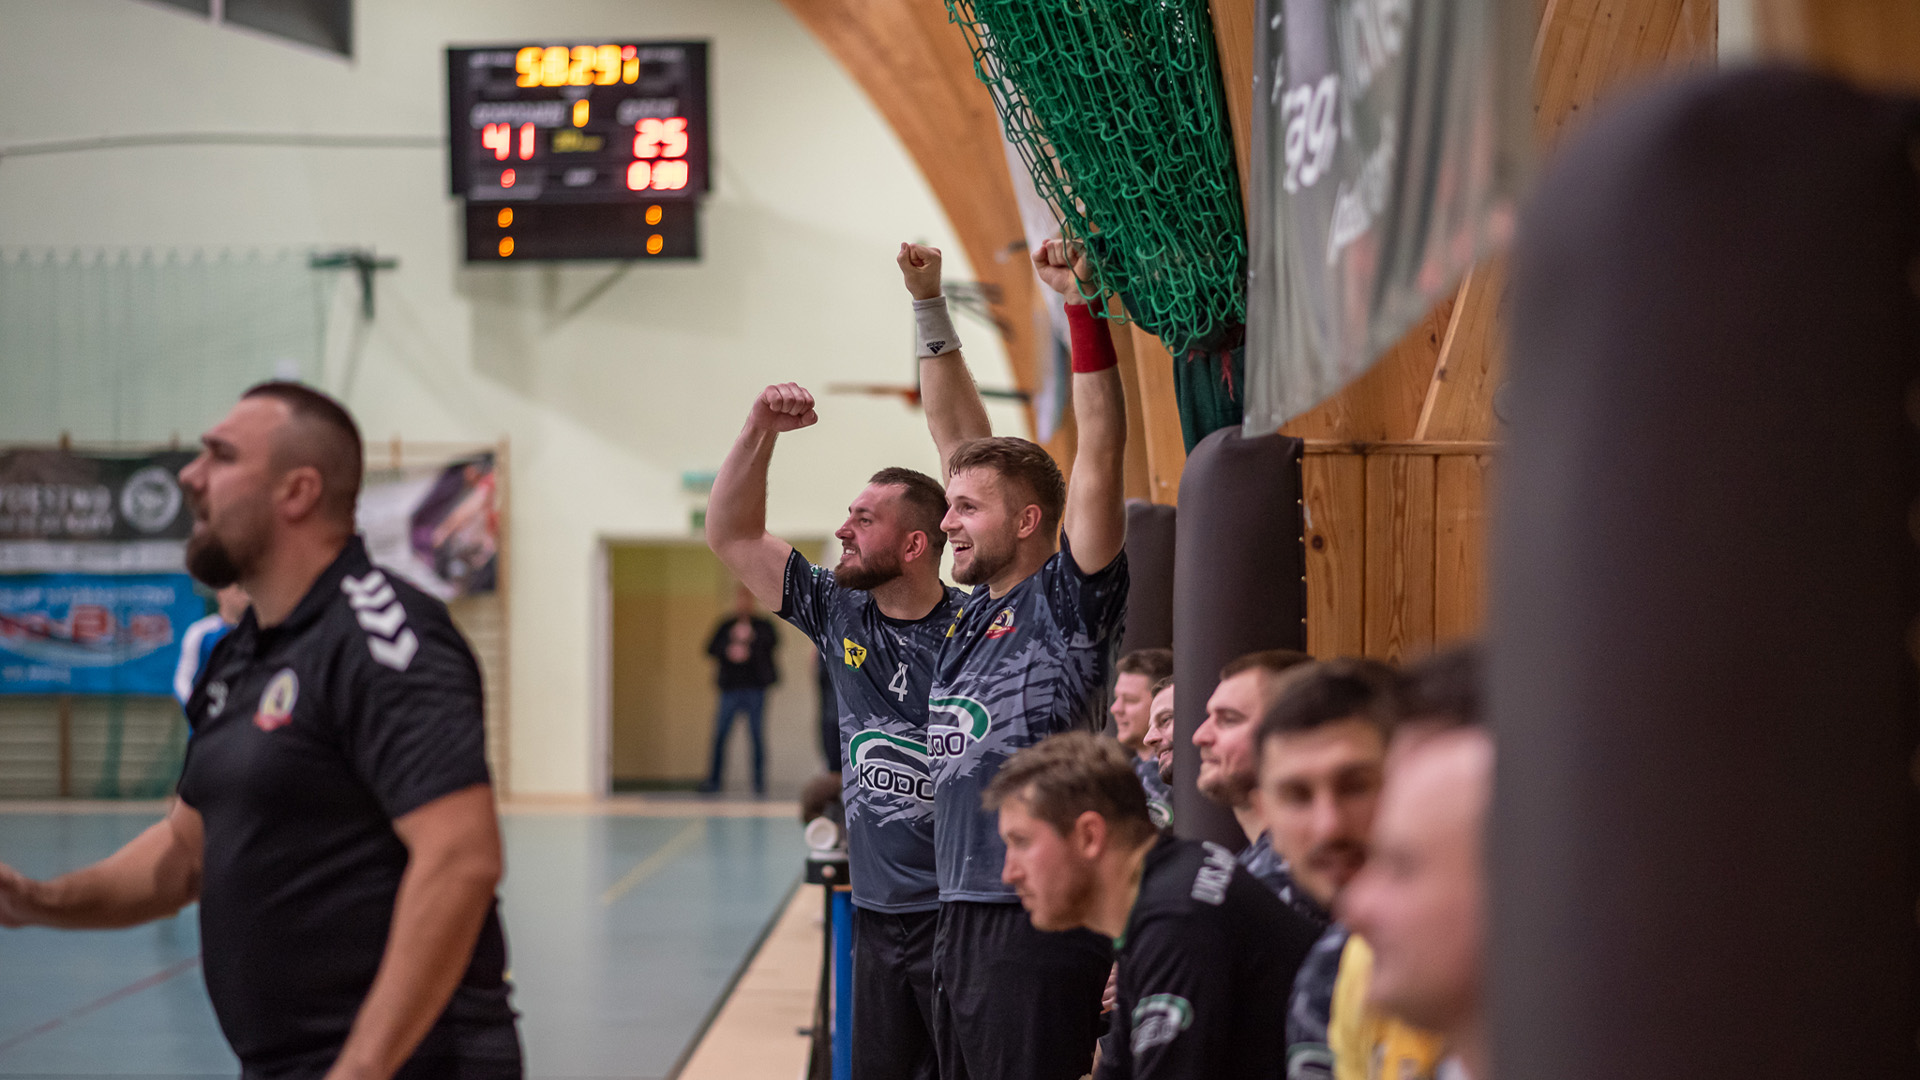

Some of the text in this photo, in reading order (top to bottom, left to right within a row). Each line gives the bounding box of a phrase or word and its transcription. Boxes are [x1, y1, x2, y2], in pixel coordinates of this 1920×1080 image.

[482, 121, 535, 161] 41
[633, 117, 688, 158] 25
[888, 661, 909, 702] 4
